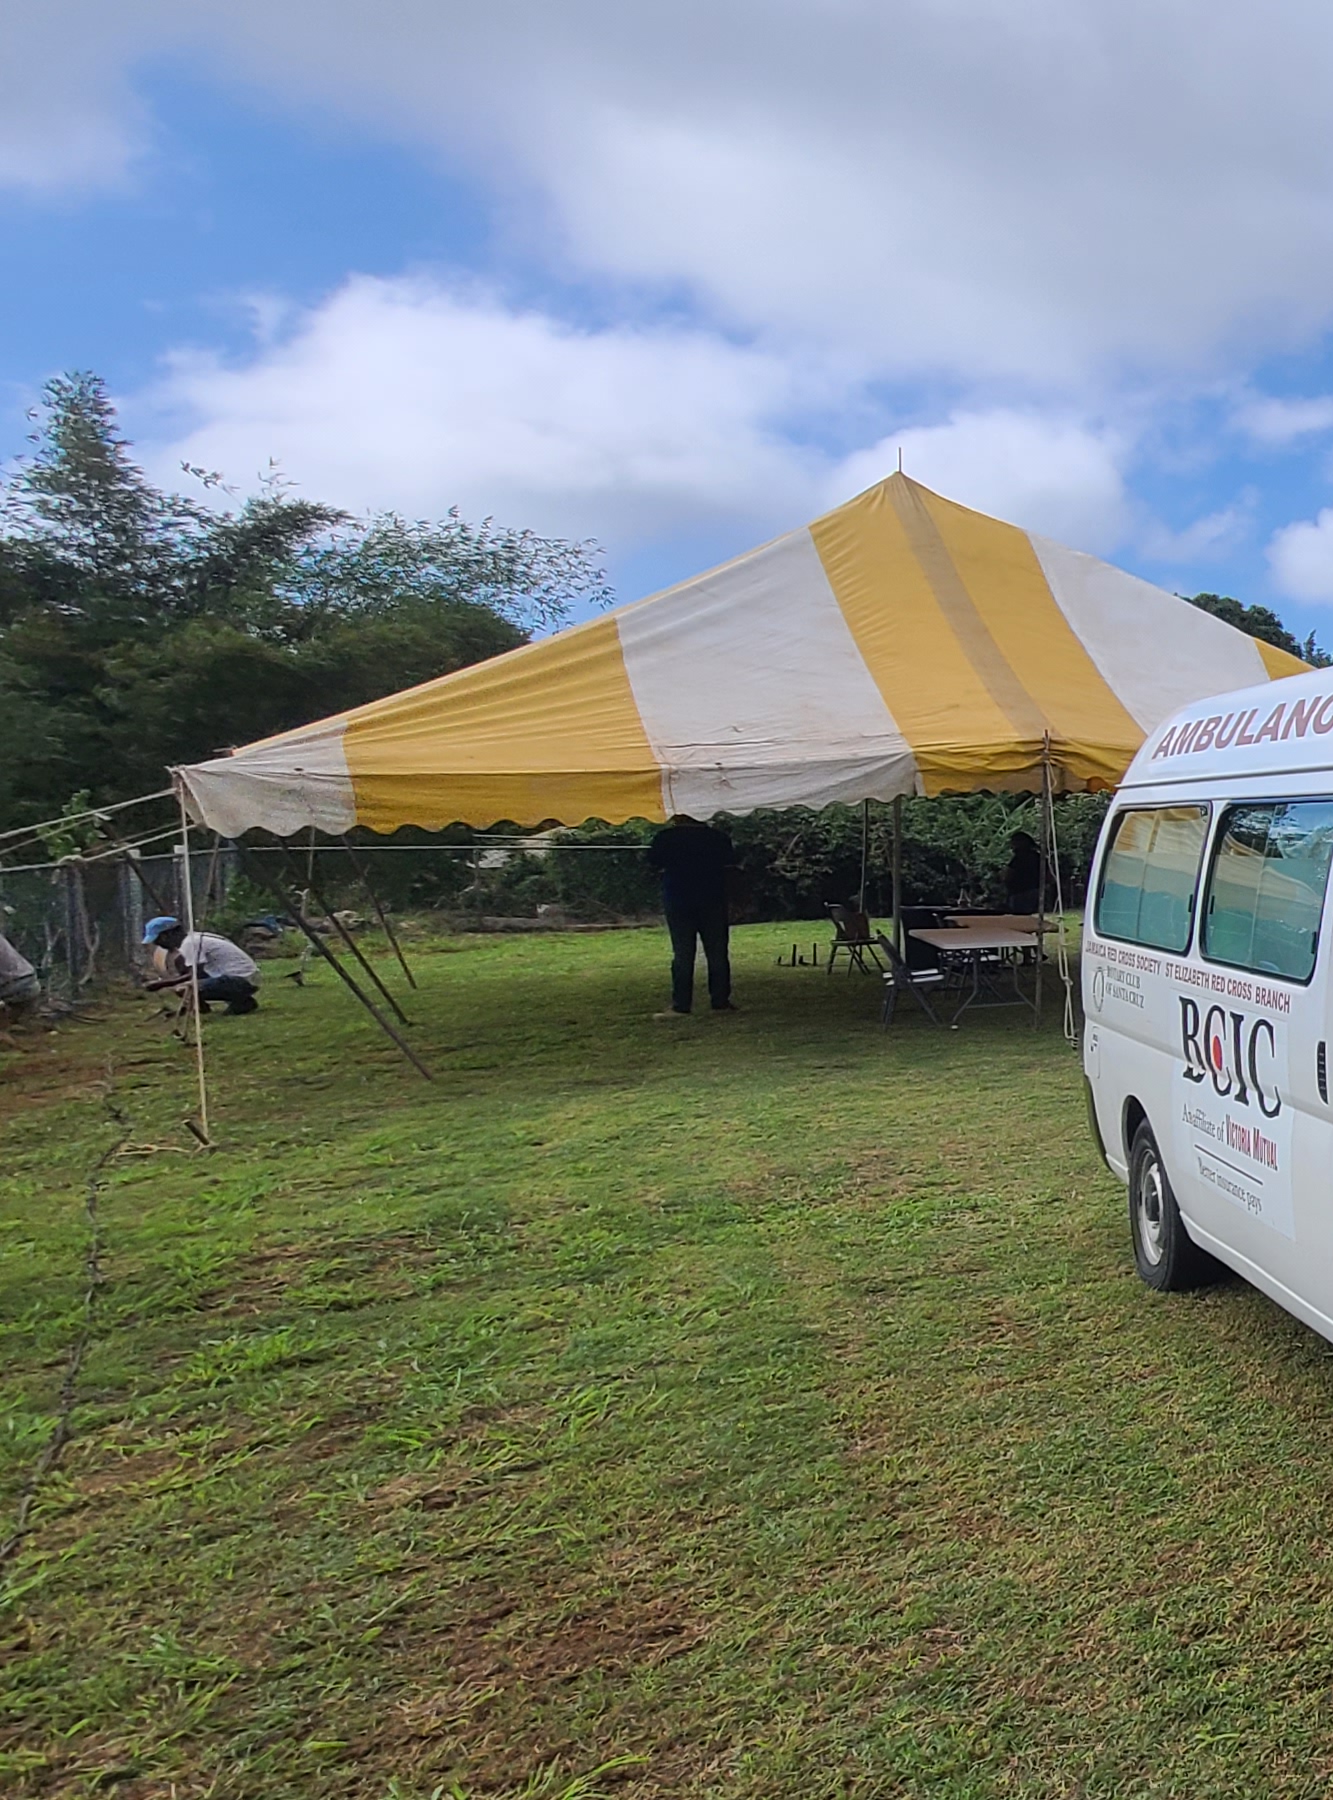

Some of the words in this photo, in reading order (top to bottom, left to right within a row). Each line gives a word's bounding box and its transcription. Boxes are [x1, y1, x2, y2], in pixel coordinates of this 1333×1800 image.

[1086, 940, 1106, 959] JAMAICA
[1107, 945, 1117, 962] RED
[1118, 949, 1136, 968] CROSS
[1136, 954, 1162, 975] SOCIETY
[1165, 961, 1174, 978] ST
[1174, 964, 1210, 990] ELIZABETH
[1211, 972, 1226, 993] RED
[1227, 978, 1252, 1001] CROSS
[1255, 986, 1291, 1013] BRANCH
[1125, 972, 1141, 989] CLUB
[1105, 981, 1112, 995] OF
[1112, 984, 1129, 1002] SANTA
[1129, 989, 1145, 1009] CRUZ
[1179, 995, 1282, 1118] BCIC
[1216, 1121, 1225, 1142] of
